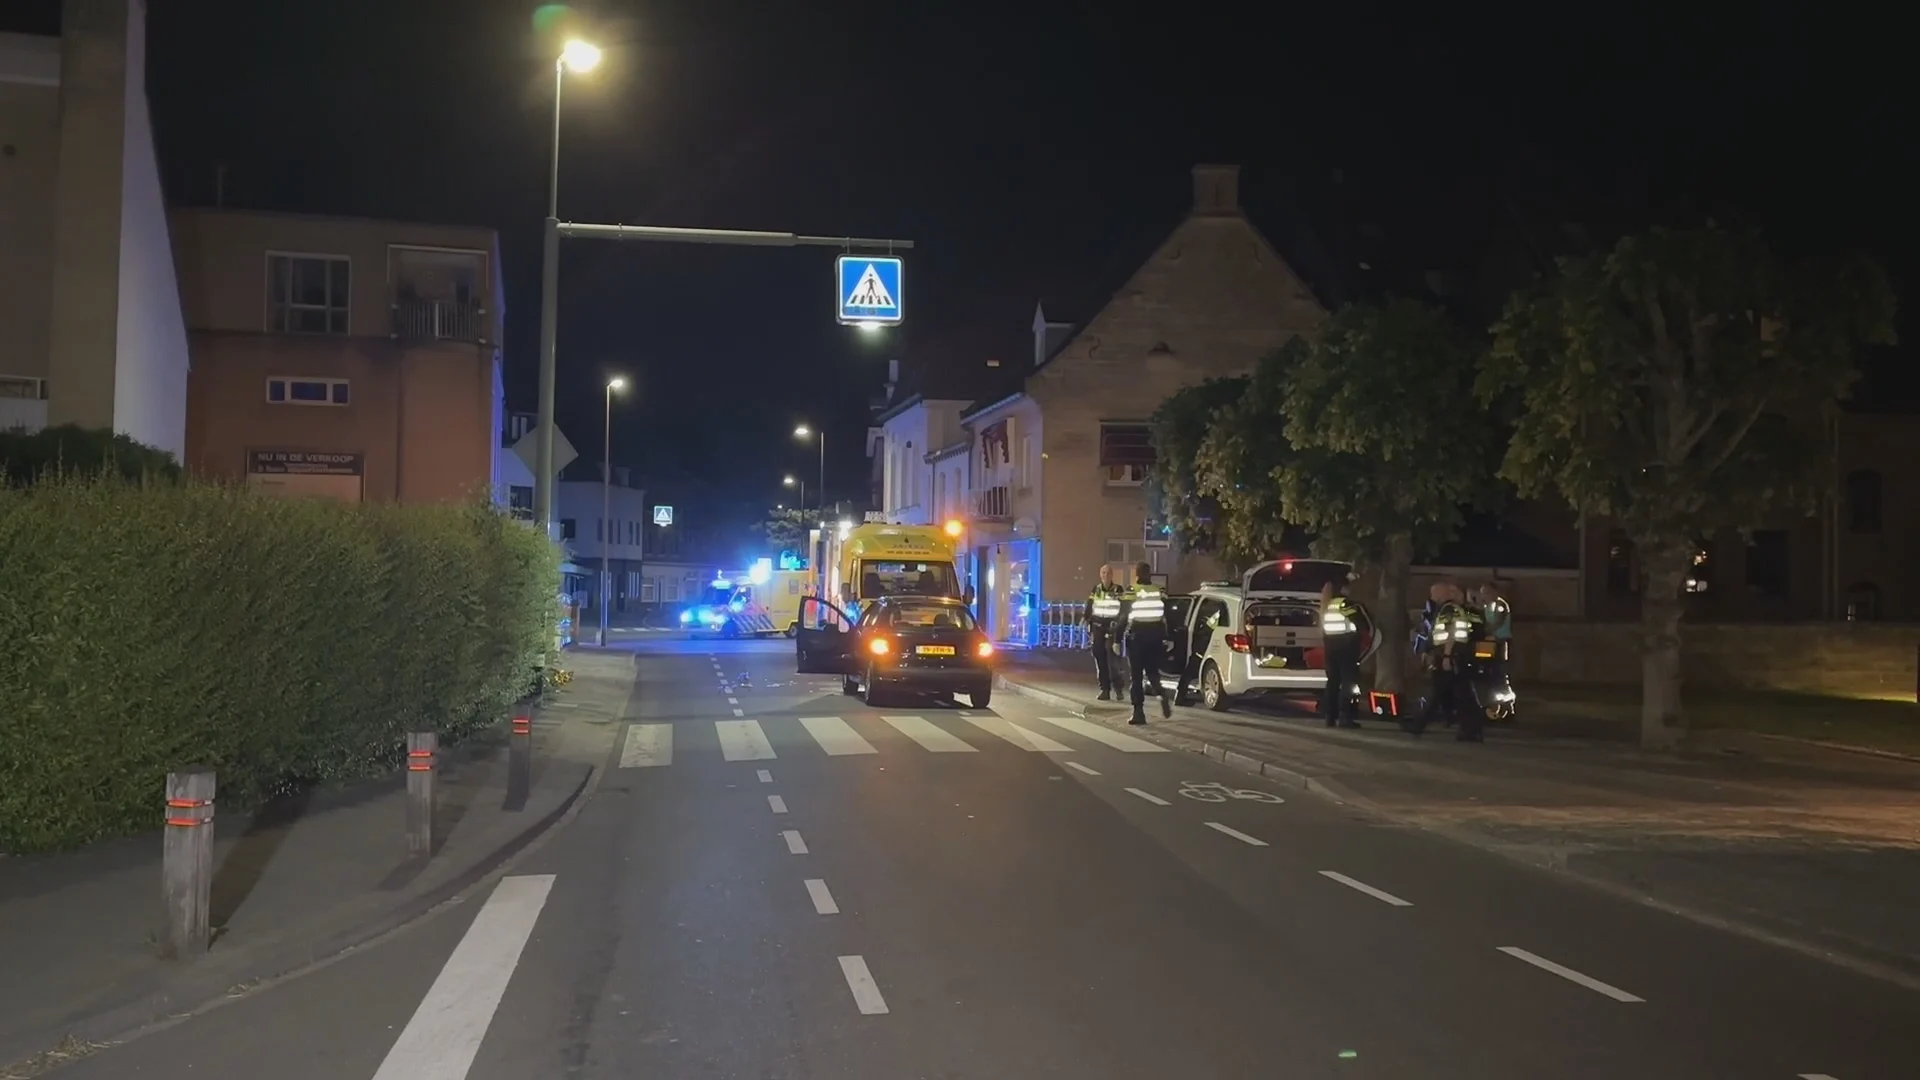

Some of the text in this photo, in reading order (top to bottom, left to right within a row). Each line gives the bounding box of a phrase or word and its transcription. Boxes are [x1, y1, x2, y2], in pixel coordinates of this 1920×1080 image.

[257, 453, 354, 463] NU IN DE VERKOOP
